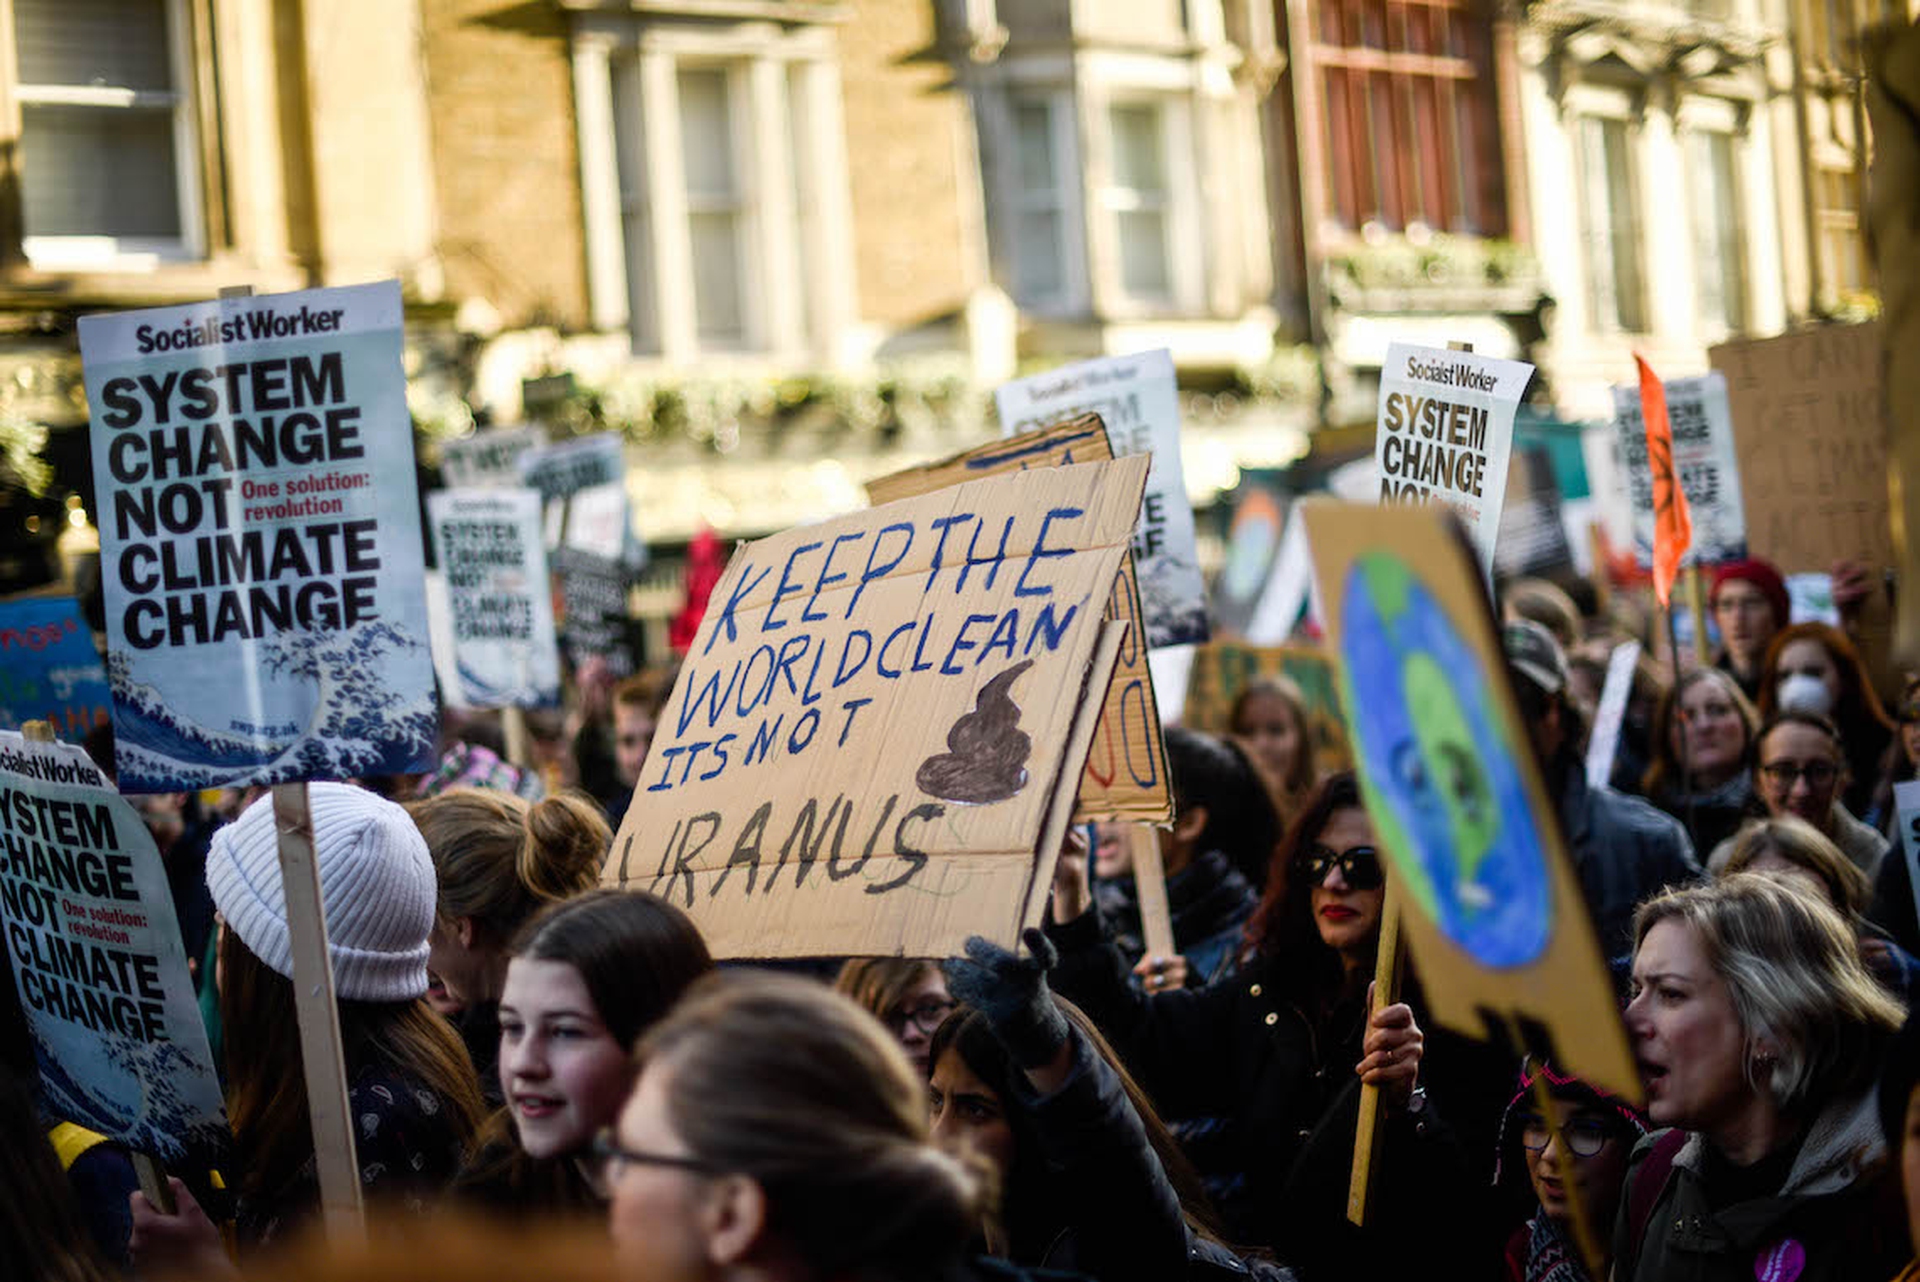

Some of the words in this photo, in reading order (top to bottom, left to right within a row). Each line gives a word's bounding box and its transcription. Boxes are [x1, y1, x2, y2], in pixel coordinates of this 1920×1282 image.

[136, 314, 246, 353] Socialist
[247, 306, 344, 339] Worker
[101, 351, 347, 429] SYSTEM
[1455, 364, 1498, 392] Worker
[109, 407, 365, 484] CHANGE
[1384, 392, 1488, 450] SYSTEM
[1383, 435, 1487, 497] CHANGE
[114, 478, 233, 540] NOT
[241, 479, 280, 499] One
[286, 471, 371, 495] solution:
[244, 498, 343, 522] revolution
[119, 519, 381, 595] CLIMATE
[704, 522, 914, 656] KEEP
[926, 508, 1084, 597] THE
[124, 577, 380, 650] CHANGE
[677, 630, 872, 739] WORLD
[876, 596, 1088, 679] CLEAN
[648, 733, 737, 792] ITS
[743, 698, 873, 767] NOT
[617, 793, 946, 909] URANUS
[0, 877, 61, 932] NOT
[62, 898, 88, 918] One
[89, 905, 148, 928] solution:
[67, 921, 130, 944] revolution
[10, 922, 166, 1000] CLIMATE
[21, 967, 170, 1044] CHANGE
